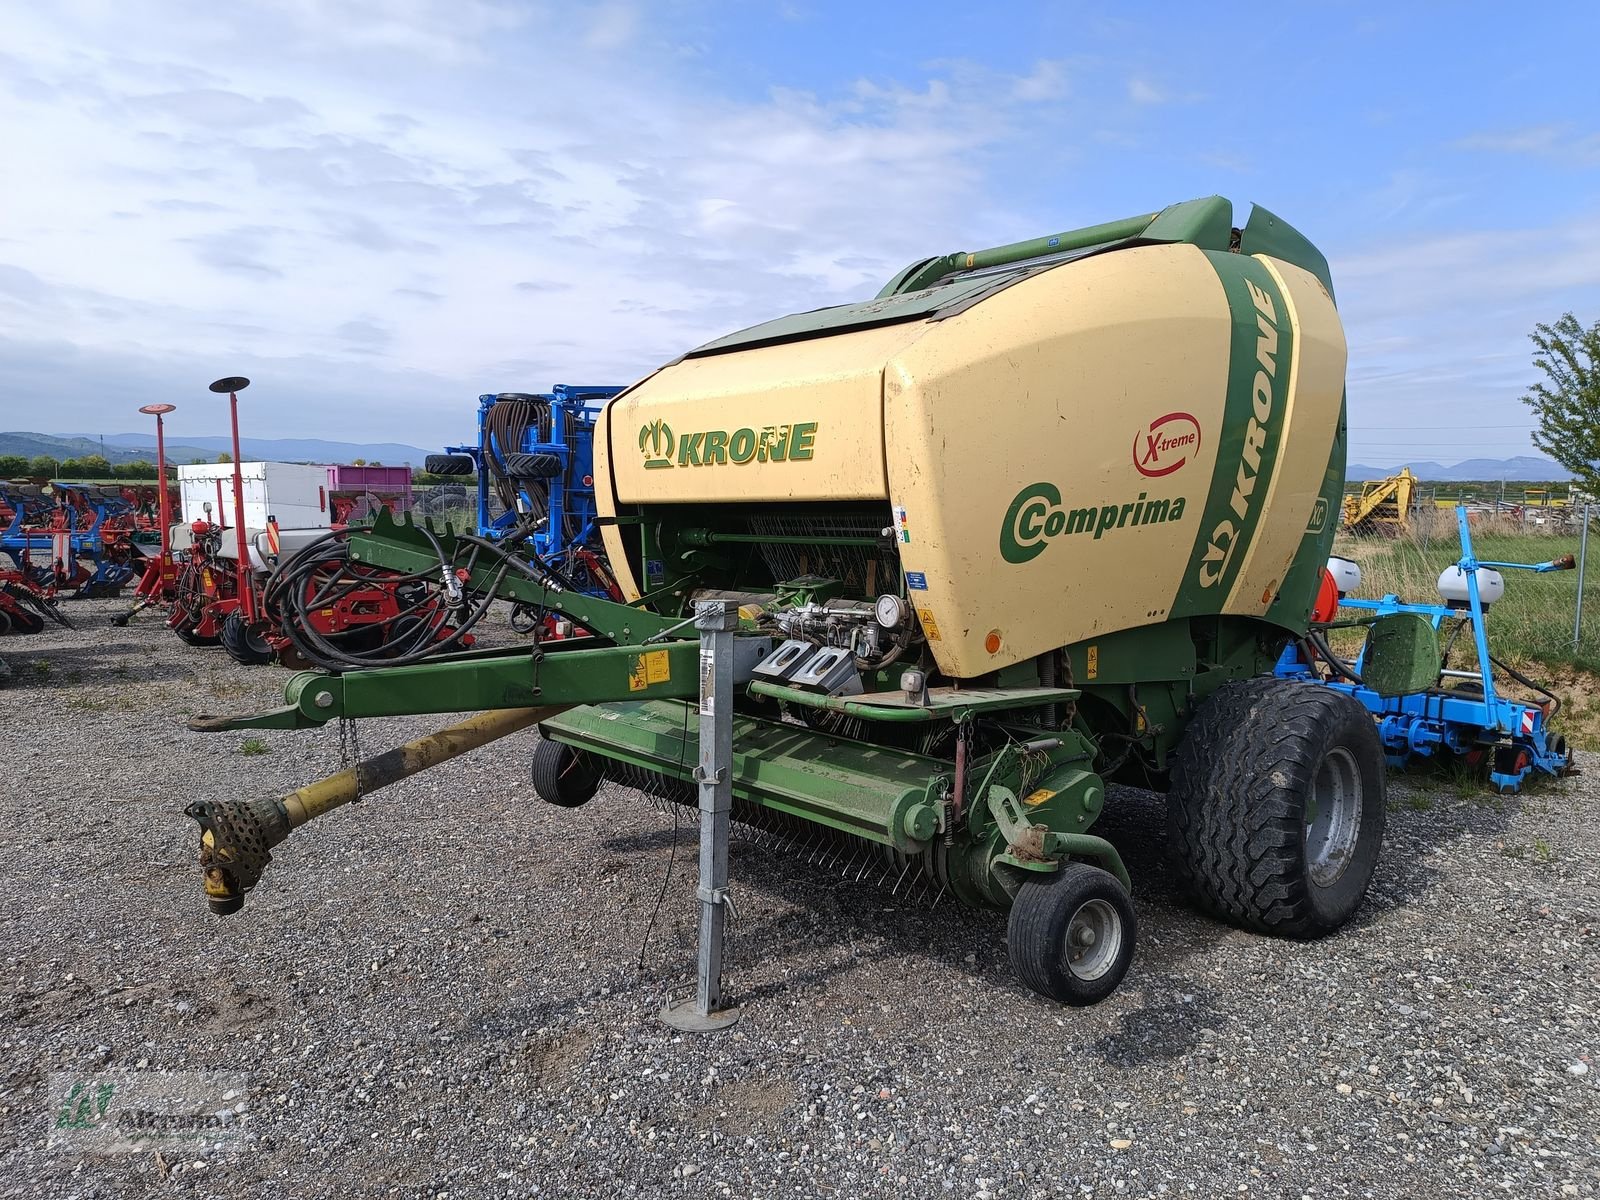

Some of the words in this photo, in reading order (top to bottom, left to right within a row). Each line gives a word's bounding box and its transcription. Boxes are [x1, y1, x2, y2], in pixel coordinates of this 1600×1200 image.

[1229, 277, 1280, 521] KRONE
[678, 421, 818, 467] KRONE
[1141, 430, 1196, 466] X-treme
[999, 482, 1187, 564] Comprima
